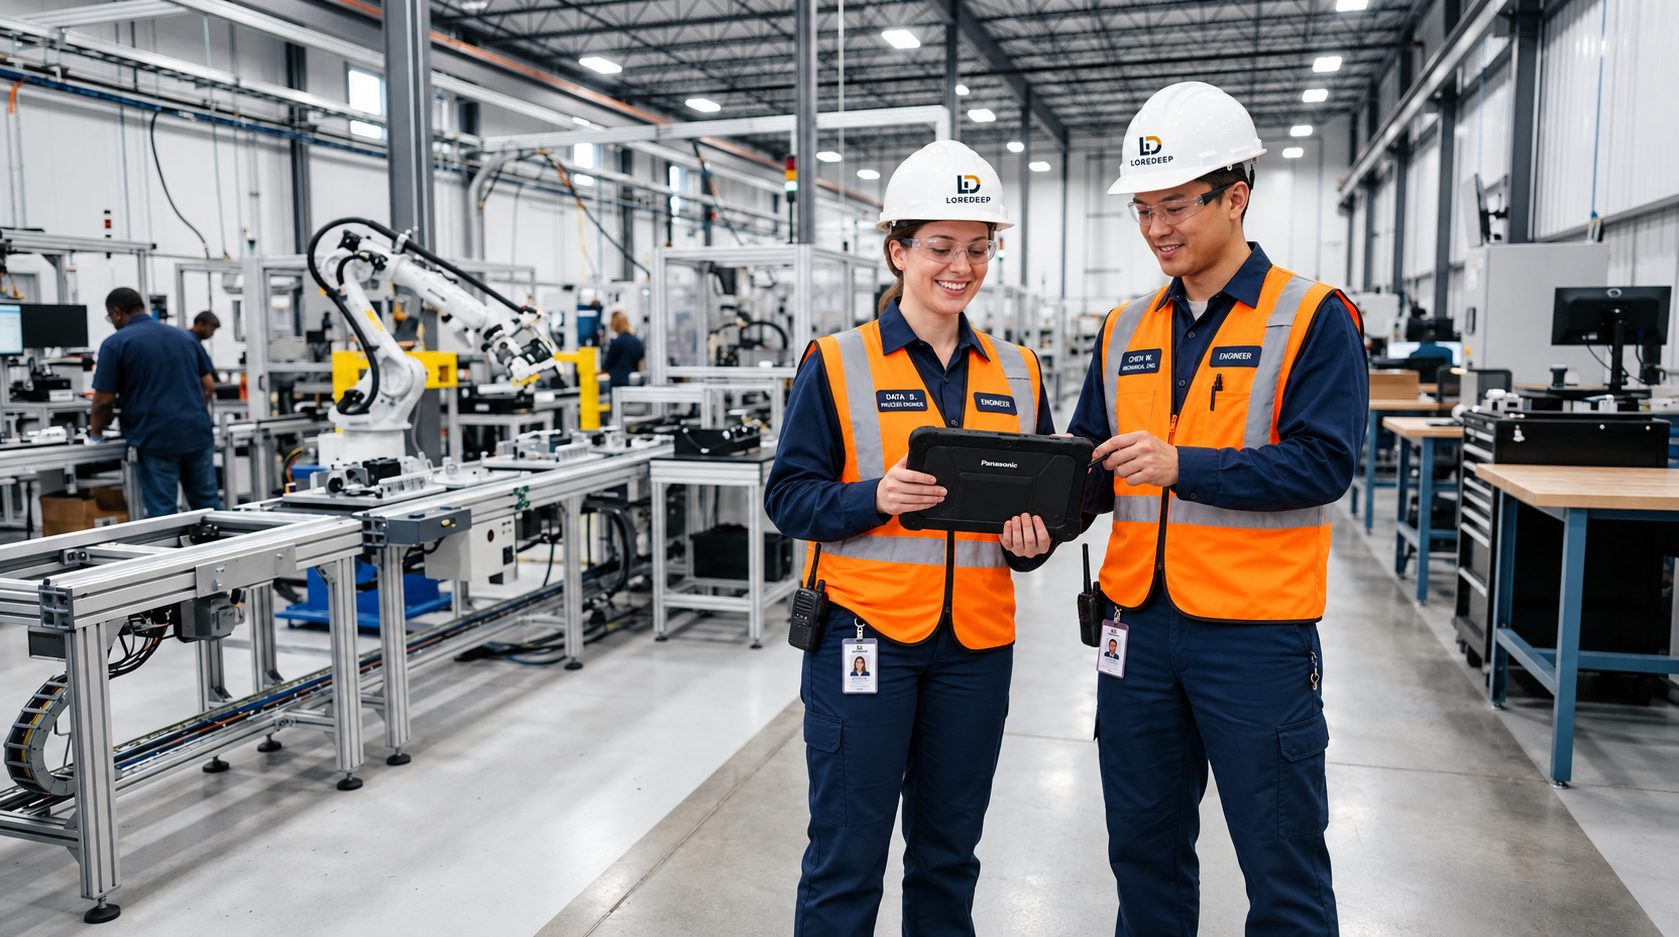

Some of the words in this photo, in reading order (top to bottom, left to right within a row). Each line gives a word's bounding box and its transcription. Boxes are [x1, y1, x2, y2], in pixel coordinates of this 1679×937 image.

[1130, 155, 1174, 167] LOREDEEP
[946, 196, 991, 204] LOREDEEP
[1219, 352, 1252, 360] ENGINEER
[980, 398, 1011, 408] ENGINEER
[981, 459, 1018, 468] Panasonic
